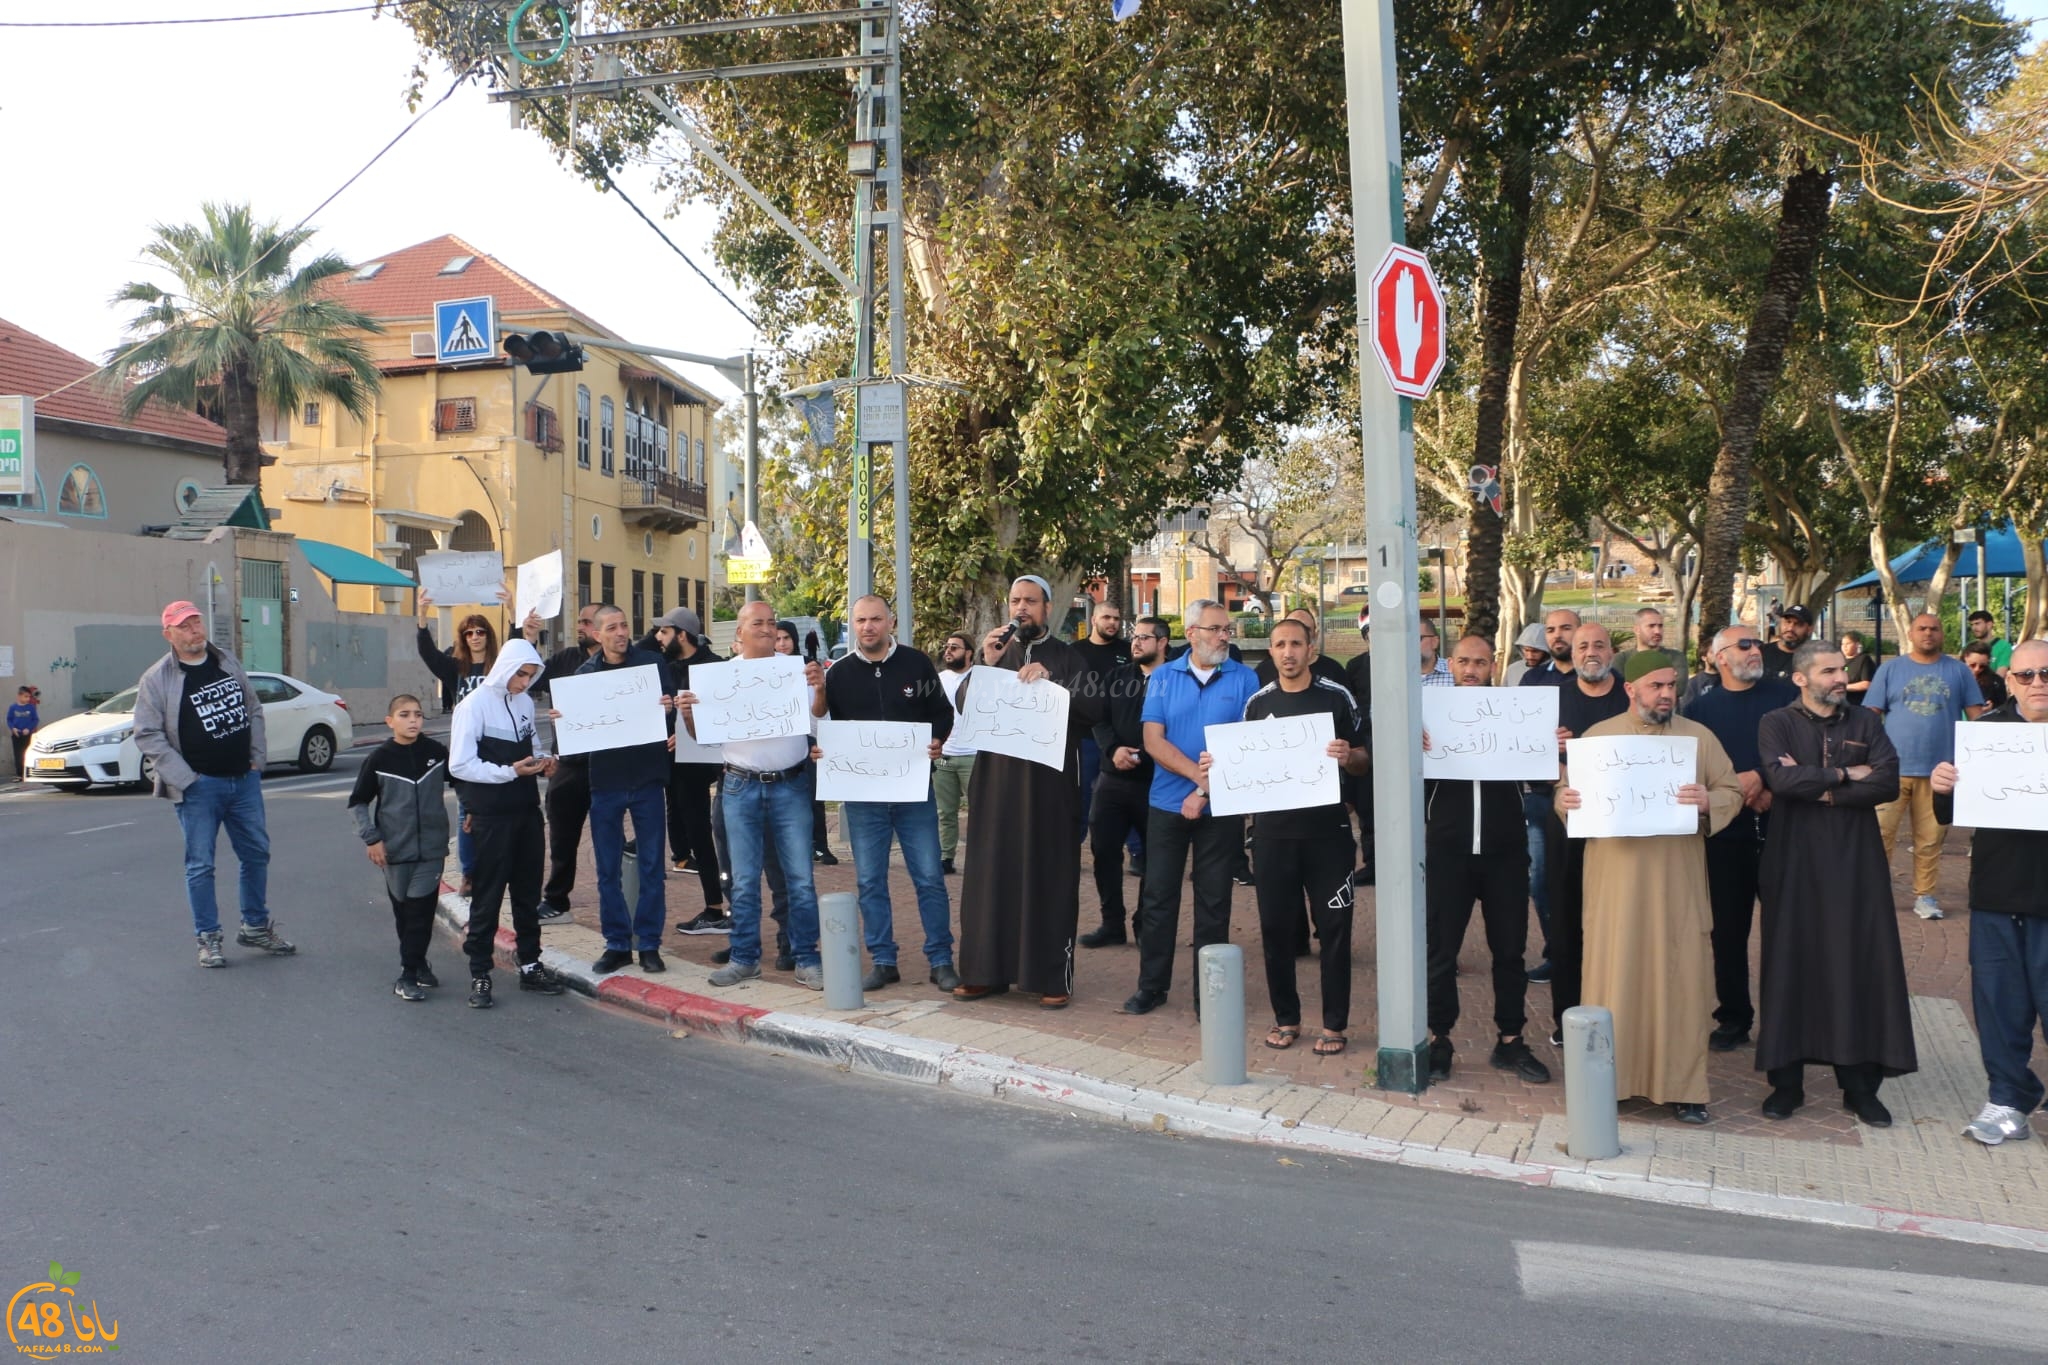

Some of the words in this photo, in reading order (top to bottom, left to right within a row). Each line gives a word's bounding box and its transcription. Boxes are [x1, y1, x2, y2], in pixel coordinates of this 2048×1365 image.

[858, 456, 868, 526] 10069
[189, 680, 241, 706] מסתכלים
[195, 691, 243, 718] לכיבוש
